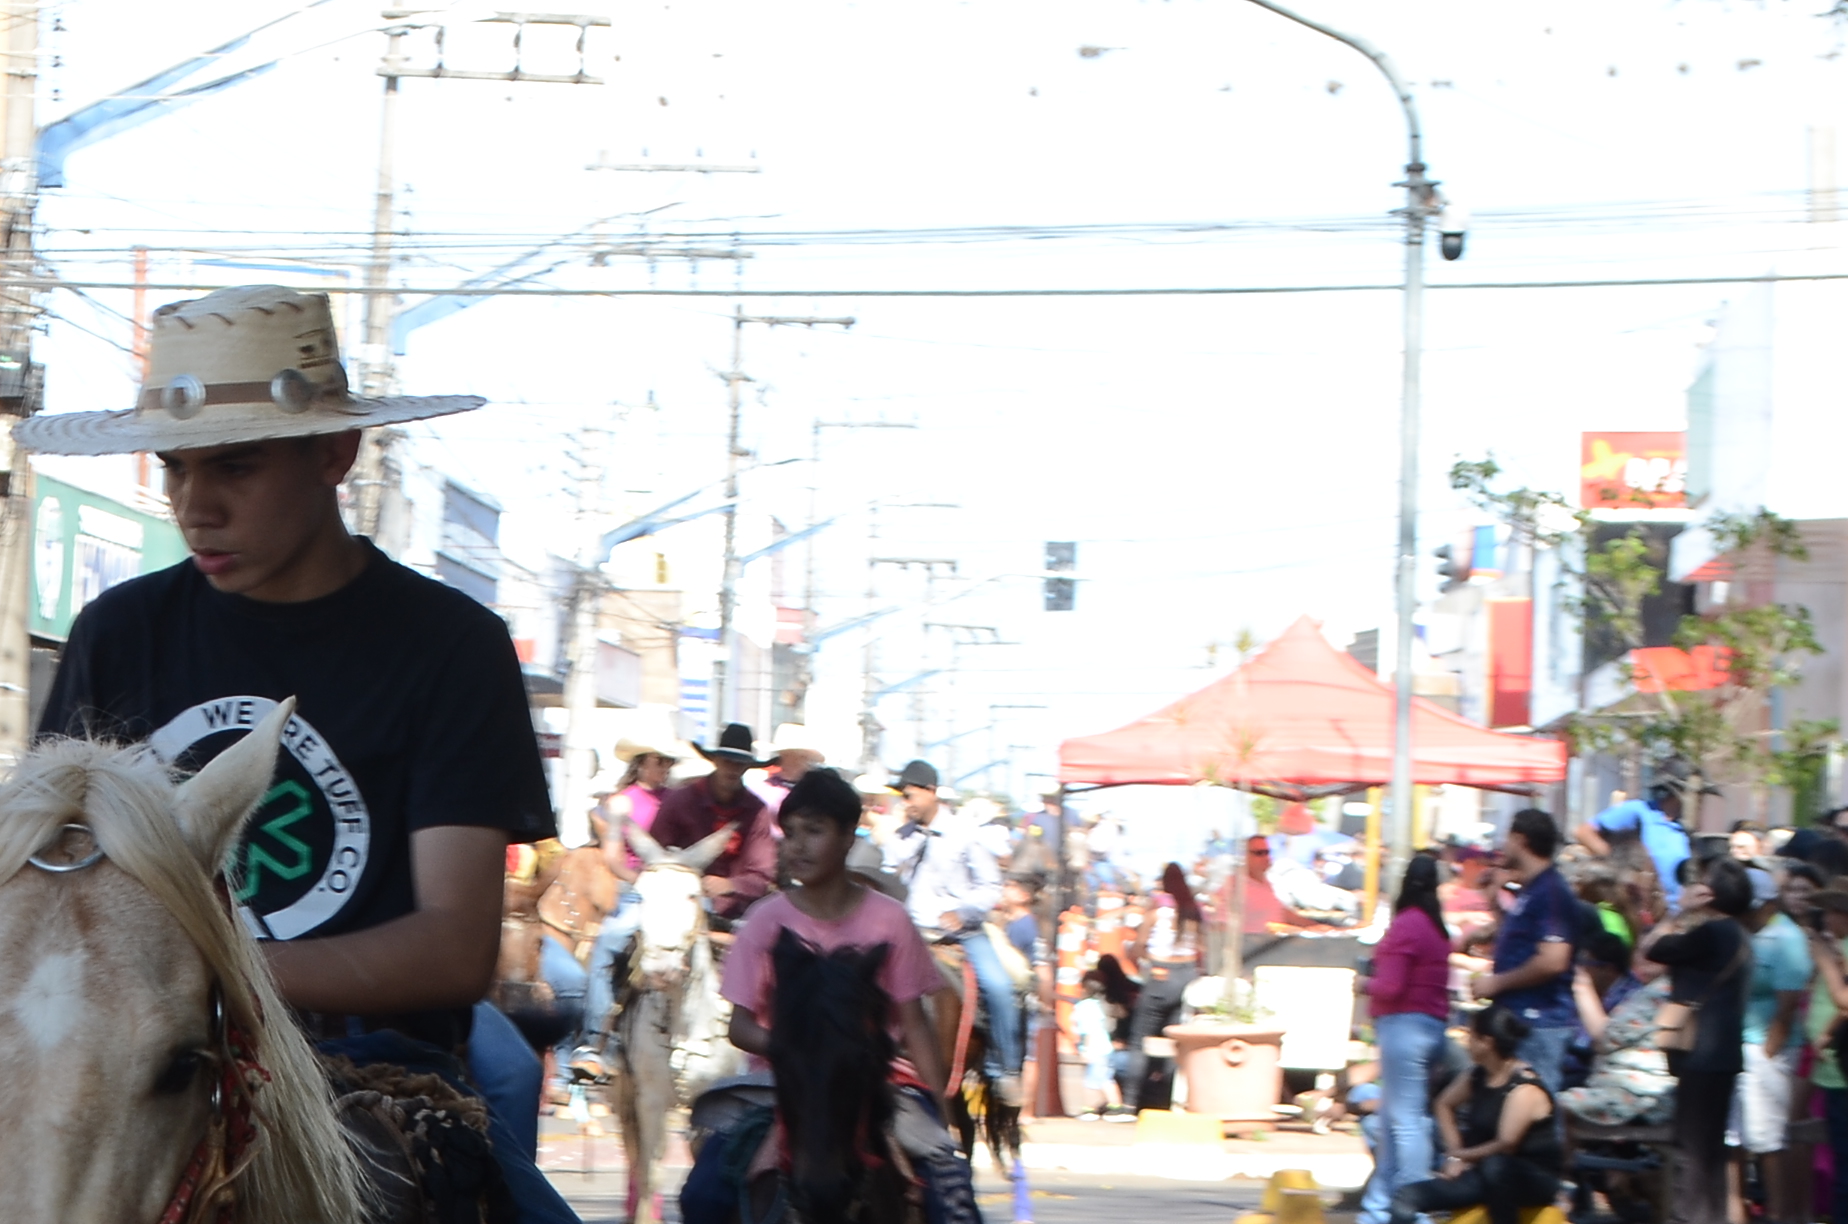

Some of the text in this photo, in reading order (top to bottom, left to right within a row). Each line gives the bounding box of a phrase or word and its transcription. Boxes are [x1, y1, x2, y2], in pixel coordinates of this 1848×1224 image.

[201, 701, 366, 894] WE RE TUFF CO.
